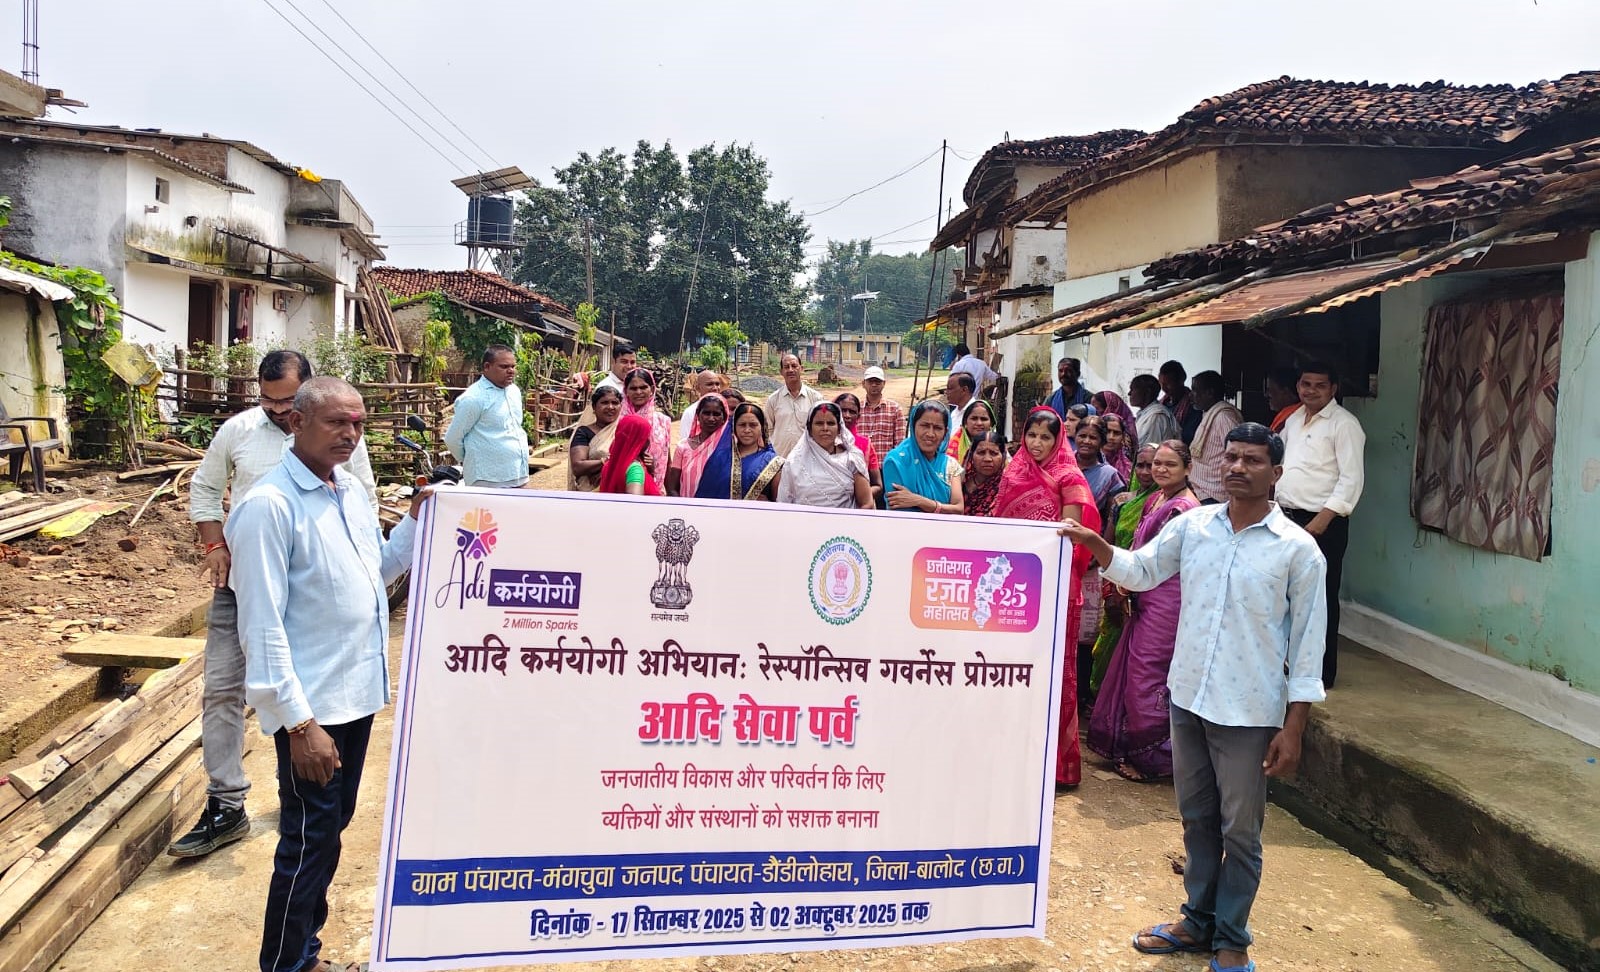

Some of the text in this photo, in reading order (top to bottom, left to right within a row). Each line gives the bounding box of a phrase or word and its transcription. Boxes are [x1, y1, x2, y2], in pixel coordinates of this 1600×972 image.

[435, 550, 576, 609] Adi कर्मयोगी
[926, 556, 972, 578] छत्तीसगढ़
[925, 577, 972, 603] रजत
[1000, 581, 1027, 607] 25
[503, 618, 578, 632] 2 Million Sparks
[923, 602, 970, 621] महोत्सव
[445, 634, 510, 675] आदि
[520, 636, 628, 676] कर्मयोगी
[757, 643, 871, 683] रेस्पॉन्सिव
[964, 651, 1033, 688] प्रोग्राम
[638, 692, 858, 744] आदि सेवा पर्व
[601, 762, 885, 793] जनजातीय विकास और परिवर्तन कि लिए
[602, 803, 880, 830] व्यक्तियों और संस्थानों को सशक्त बनाना
[411, 870, 458, 896] ग्राम
[464, 864, 616, 895] पंचायत-मंगचुवा
[621, 863, 685, 885] जनपद
[866, 854, 966, 882] जिला-बालोद
[970, 856, 1025, 879] (छ.ग.)
[530, 907, 592, 937] दिनांक
[611, 911, 629, 934] 17
[634, 904, 700, 932] सितम्बर
[704, 906, 744, 930] 2025
[750, 901, 766, 928] से
[770, 906, 790, 927] 02
[794, 904, 854, 932] अक्टूबर
[859, 903, 897, 924] 2025
[901, 901, 930, 921] तक
